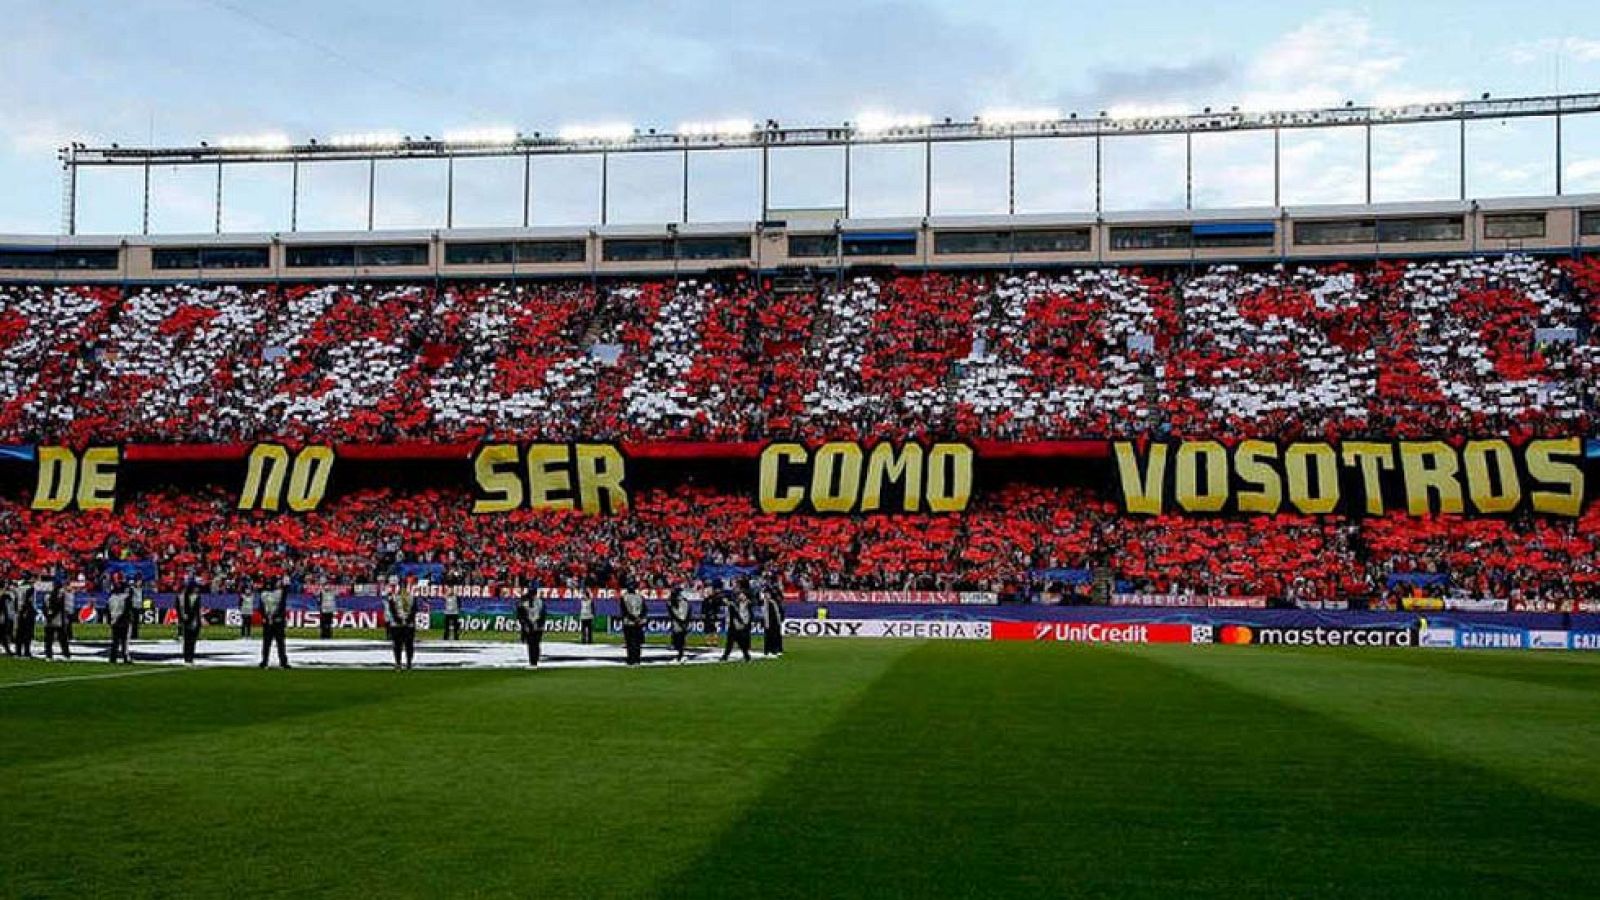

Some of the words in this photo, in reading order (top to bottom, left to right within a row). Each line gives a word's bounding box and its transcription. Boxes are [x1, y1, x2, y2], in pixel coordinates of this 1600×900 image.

[31, 445, 120, 511] DE
[238, 443, 335, 511] NO
[472, 443, 628, 515] SER
[758, 441, 974, 513] COMO
[1113, 437, 1586, 517] VOSOTROS
[784, 620, 863, 636] SONY
[883, 623, 966, 638] XPERIA
[1055, 623, 1148, 643] UniCredit
[1259, 627, 1411, 645] mastercard
